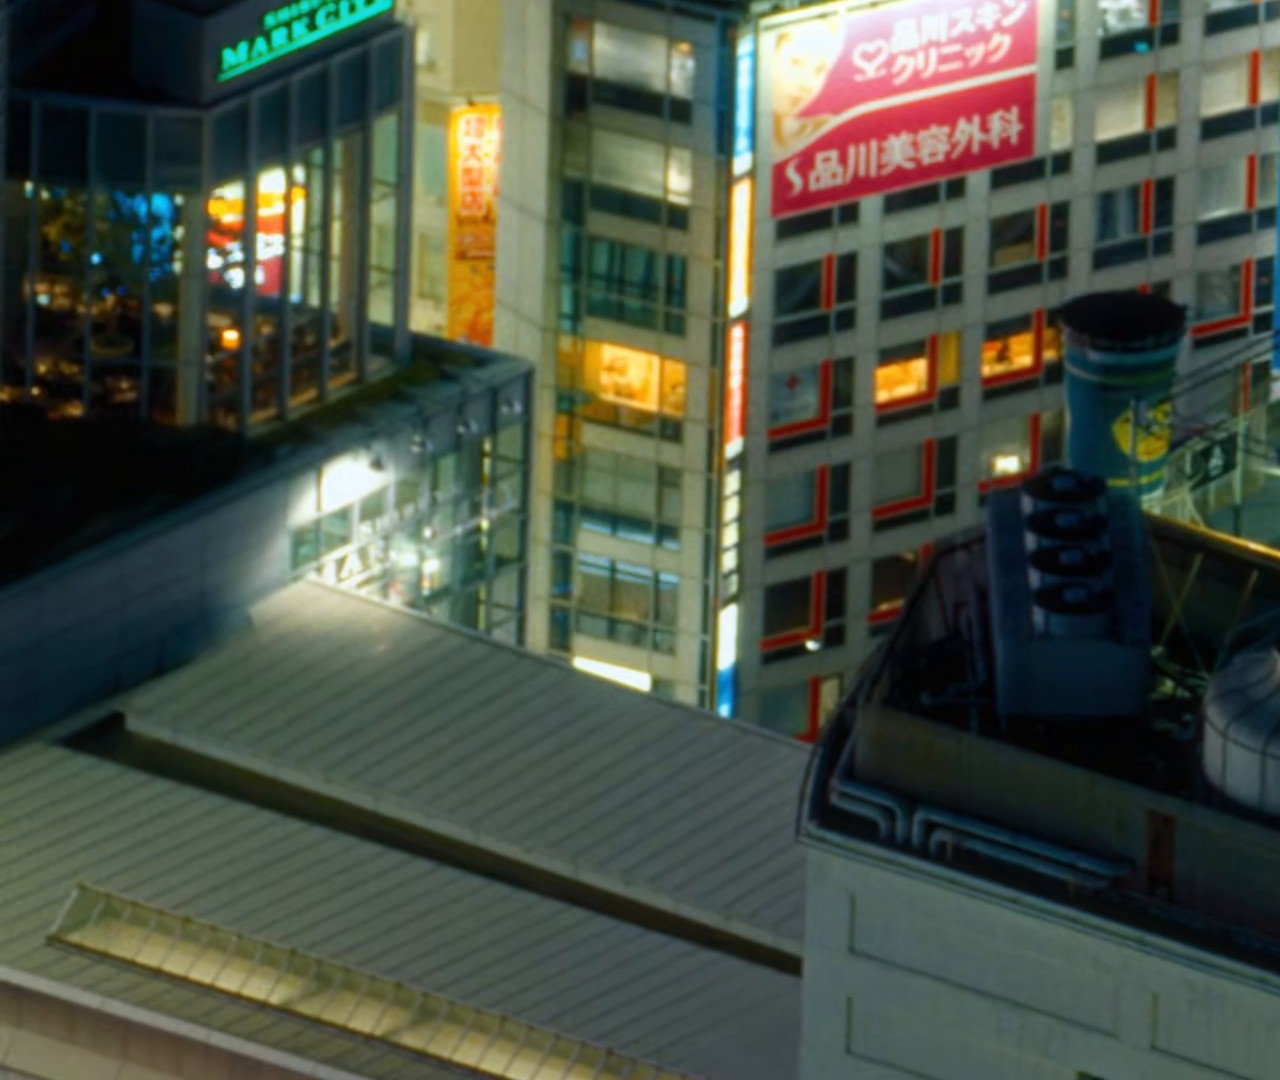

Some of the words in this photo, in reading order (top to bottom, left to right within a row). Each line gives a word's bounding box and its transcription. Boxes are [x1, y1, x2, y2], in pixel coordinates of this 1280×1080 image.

[221, 16, 310, 71] MARK
[892, 32, 1012, 86] クリニック
[808, 104, 1024, 192] 品川美容外科
